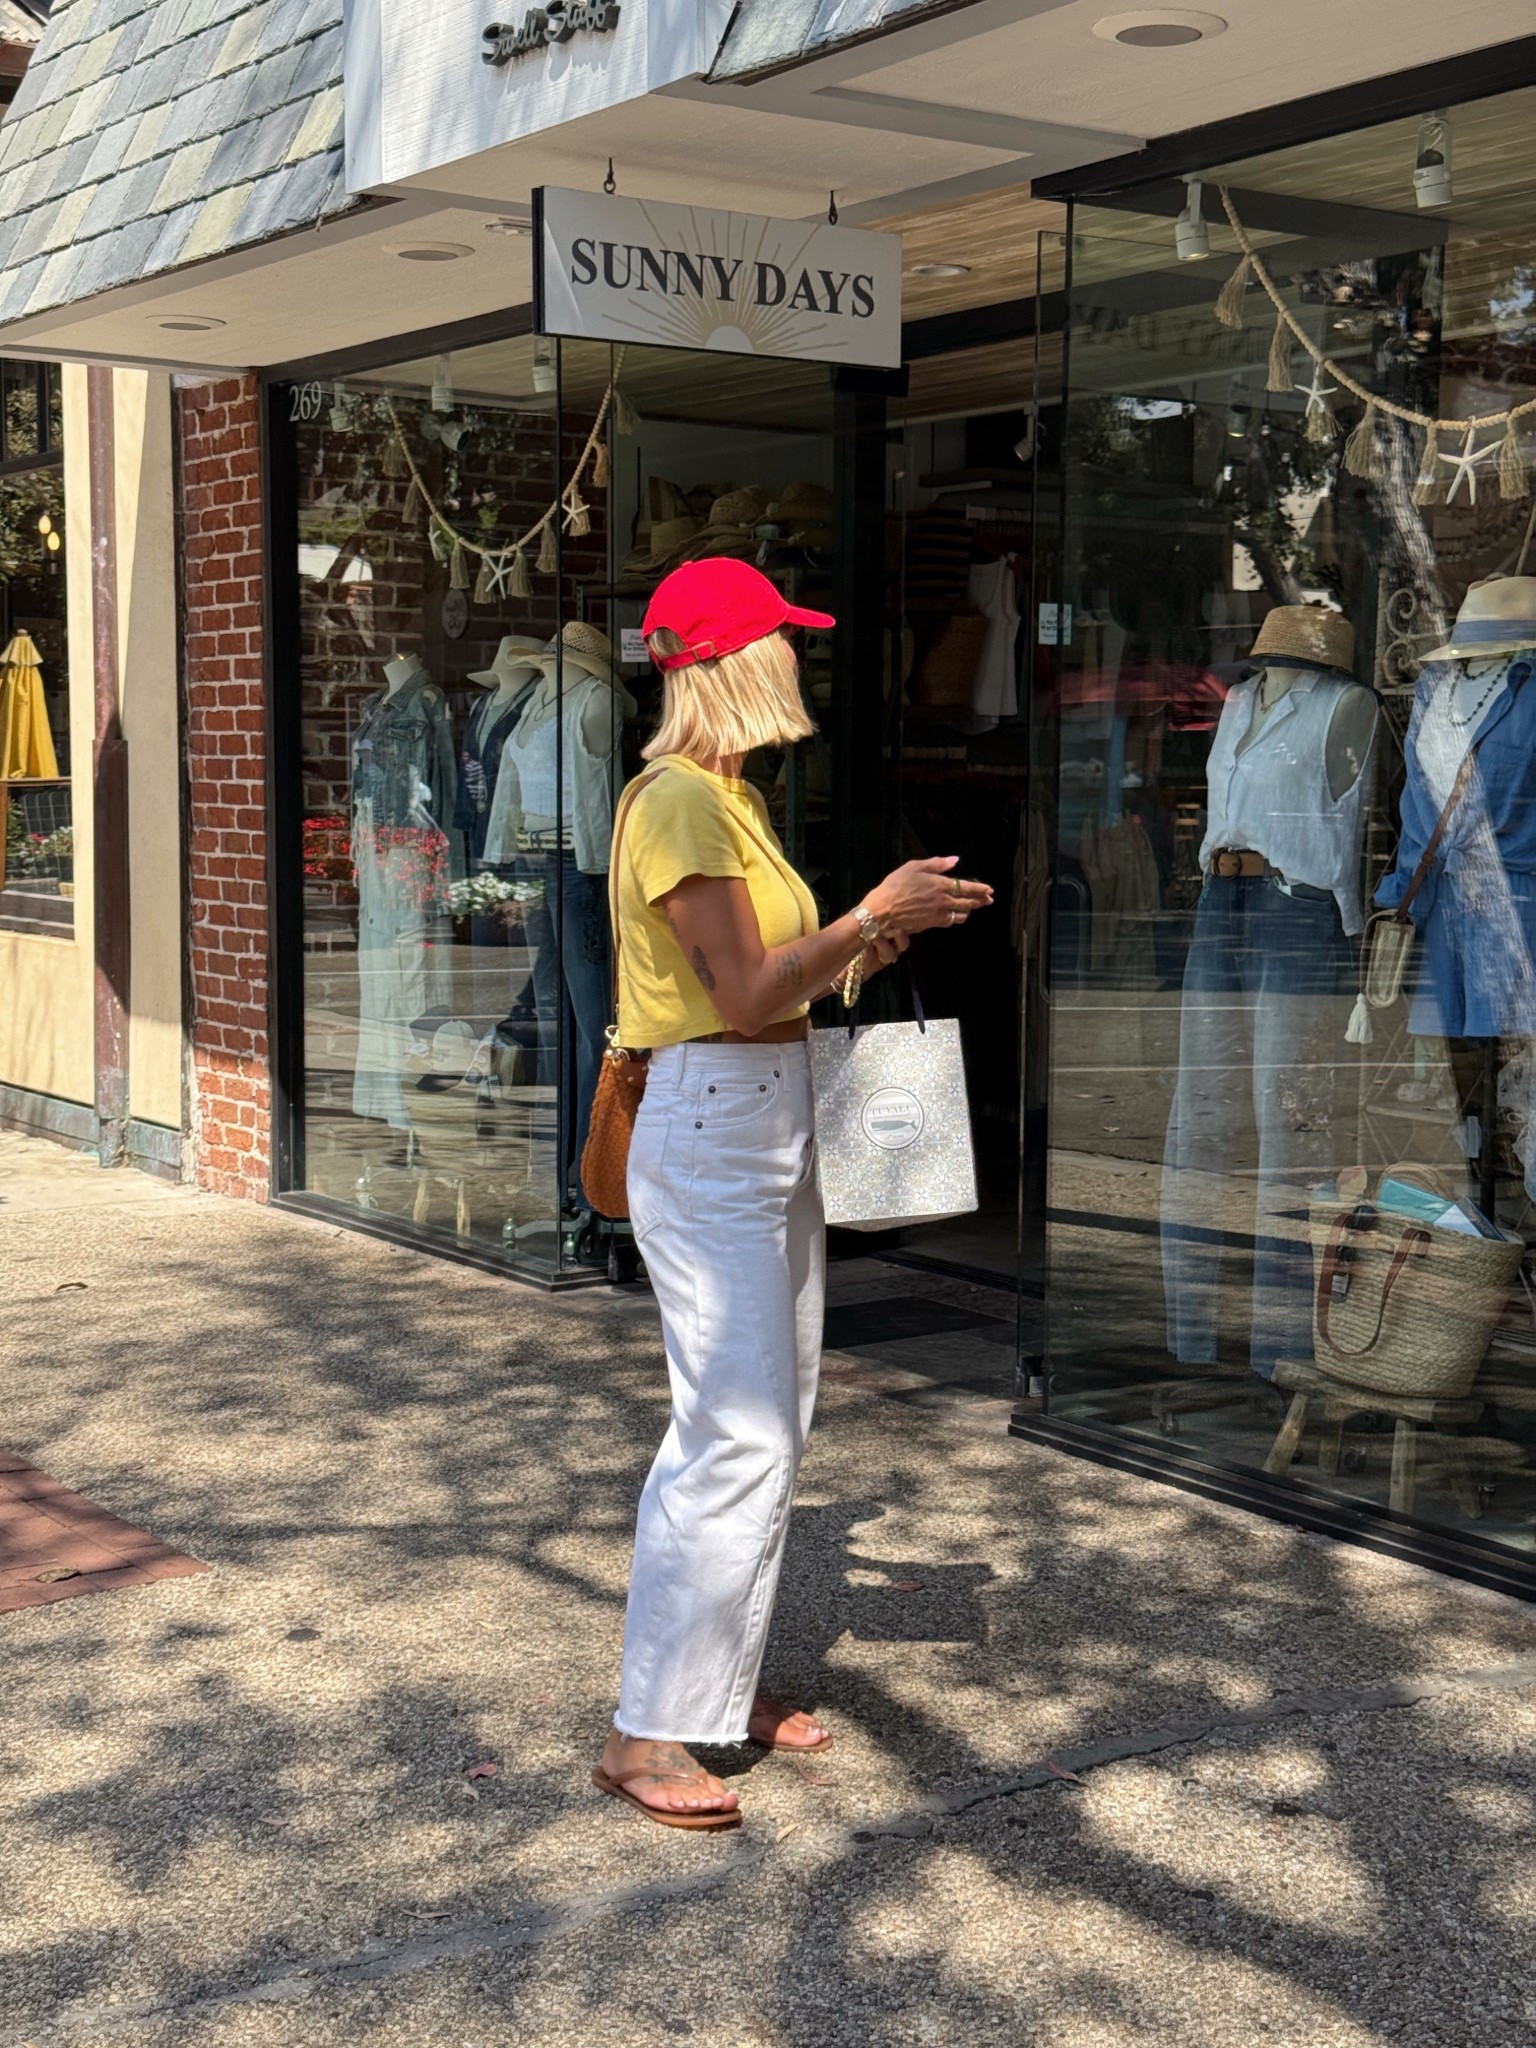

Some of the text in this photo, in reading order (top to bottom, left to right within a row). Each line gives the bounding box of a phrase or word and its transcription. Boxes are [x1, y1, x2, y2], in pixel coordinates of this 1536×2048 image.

[571, 238, 875, 318] SUNNY DAYS
[289, 381, 322, 422] 269
